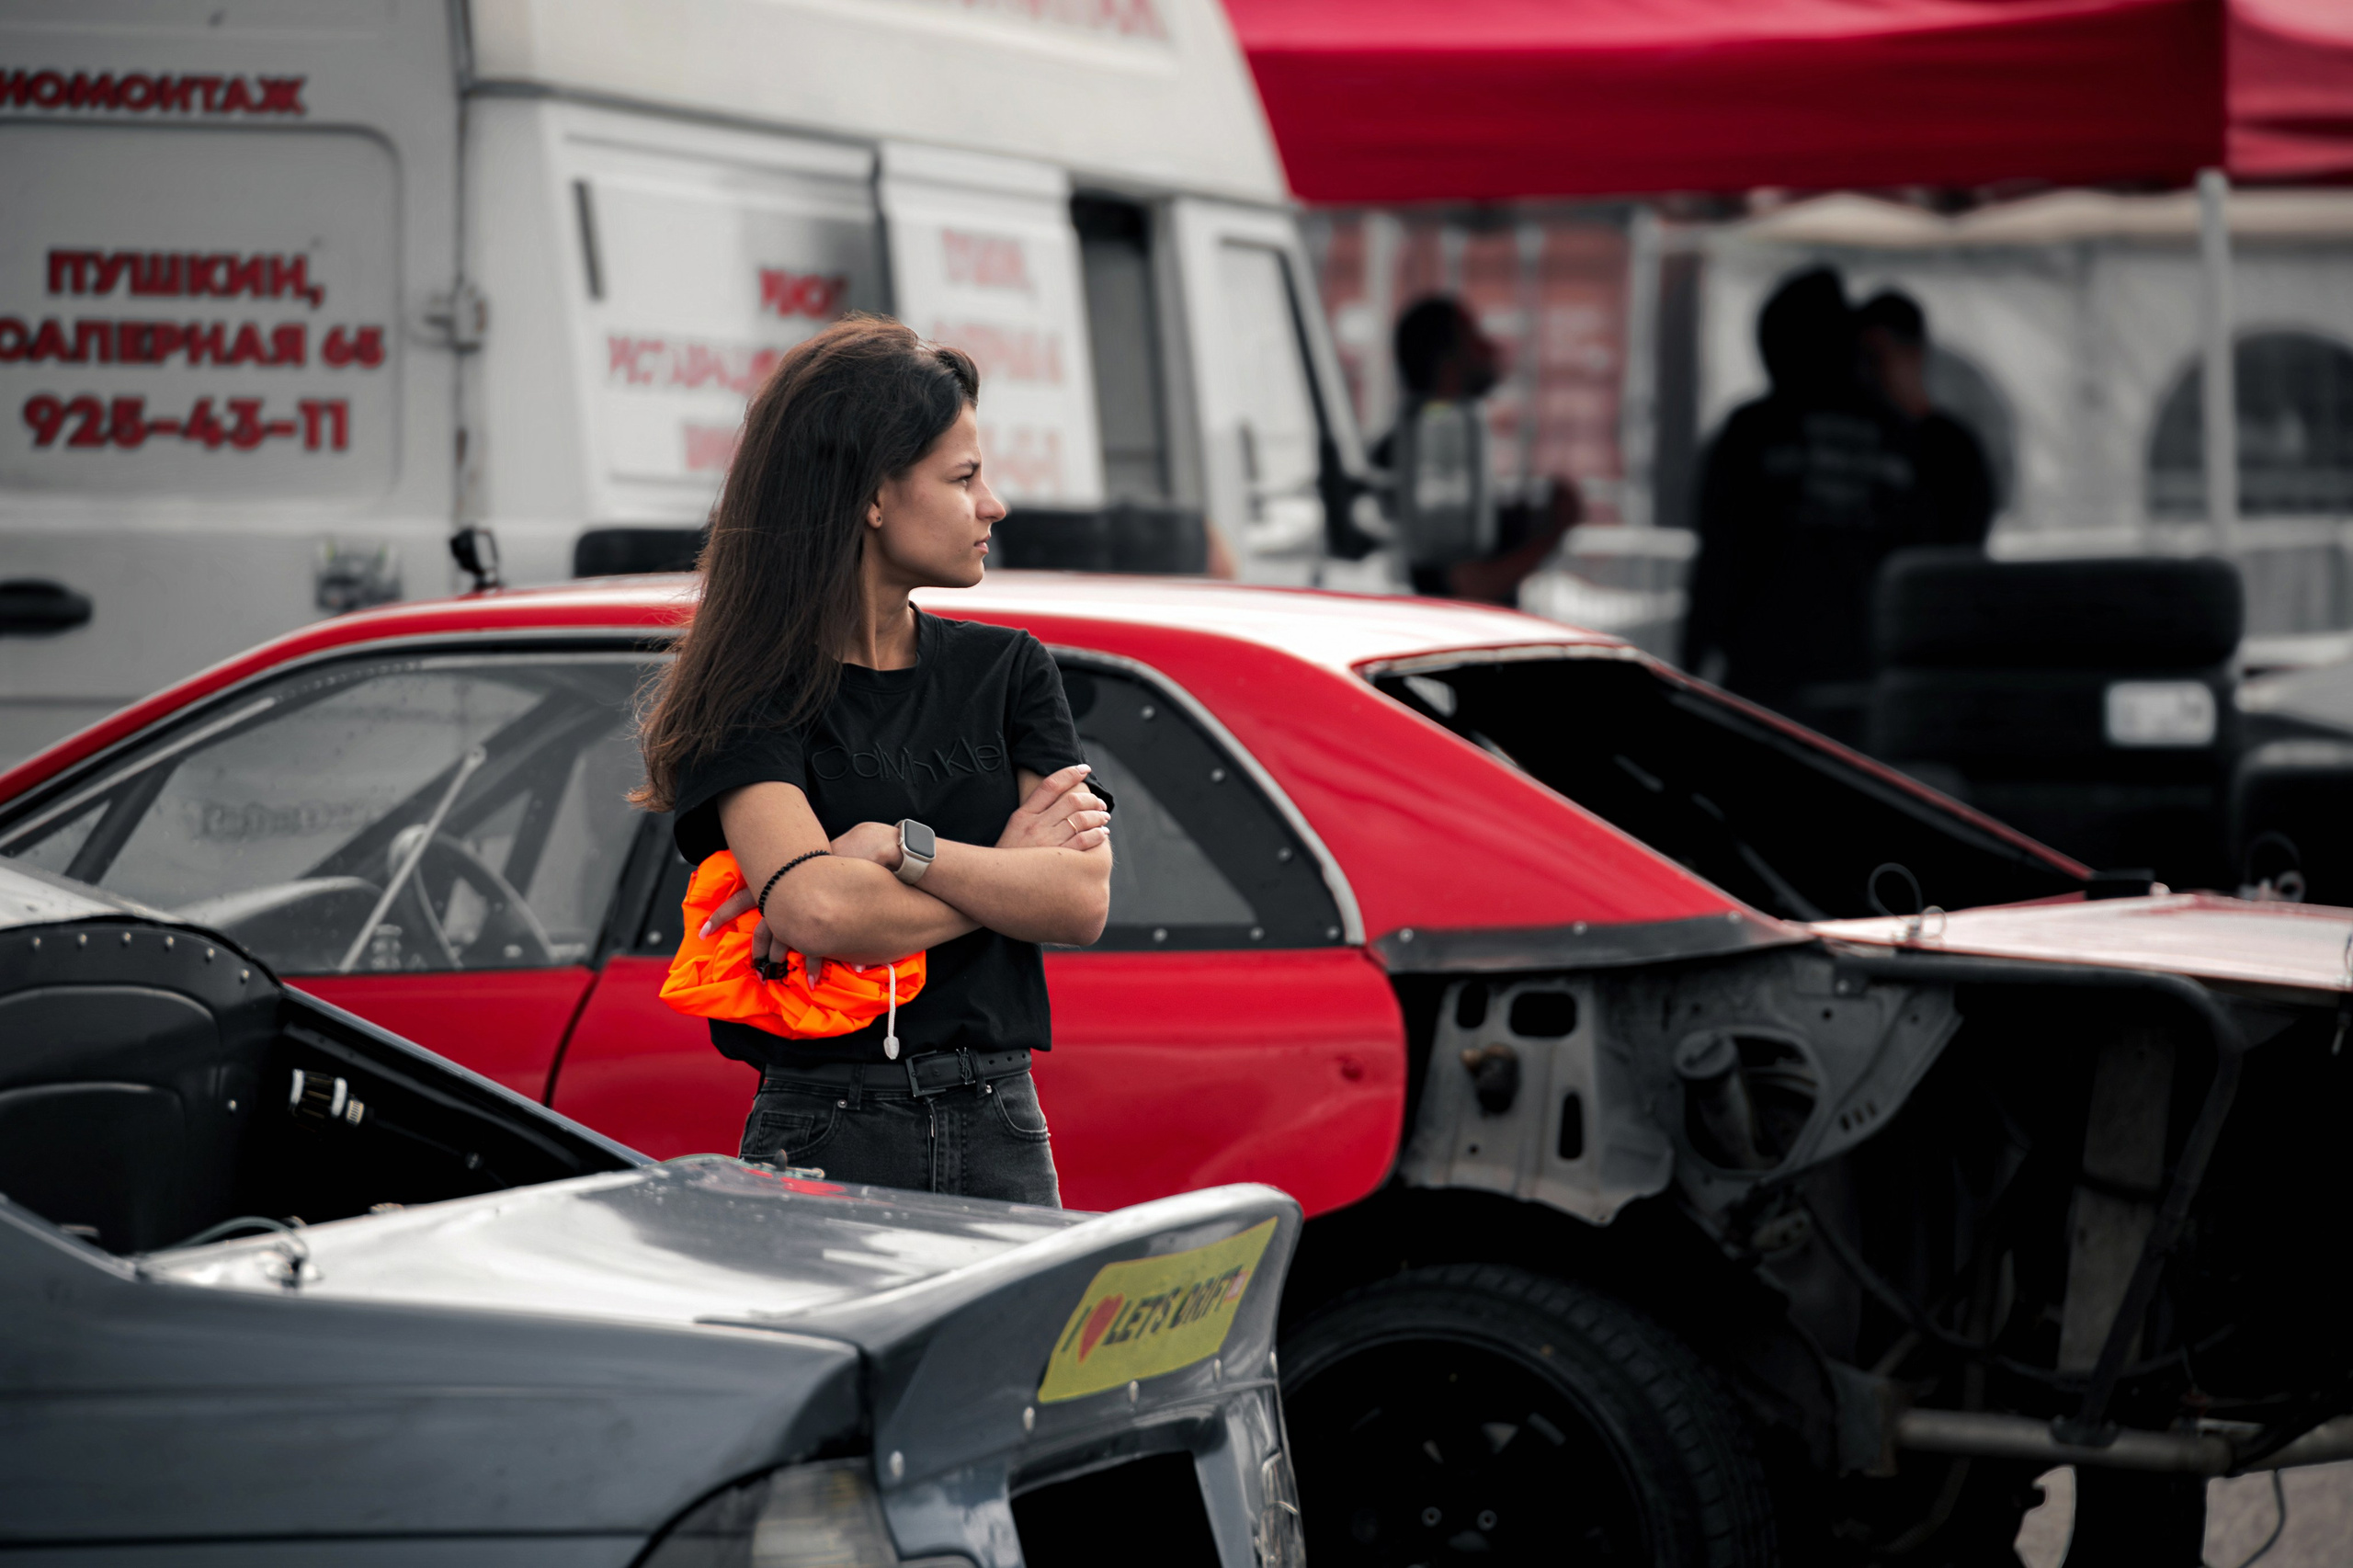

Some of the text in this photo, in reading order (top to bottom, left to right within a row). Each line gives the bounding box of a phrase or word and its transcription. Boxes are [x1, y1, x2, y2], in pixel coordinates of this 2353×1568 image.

[321, 324, 386, 369] 65
[24, 395, 349, 450] 925-43-11
[812, 741, 938, 785] Calvin
